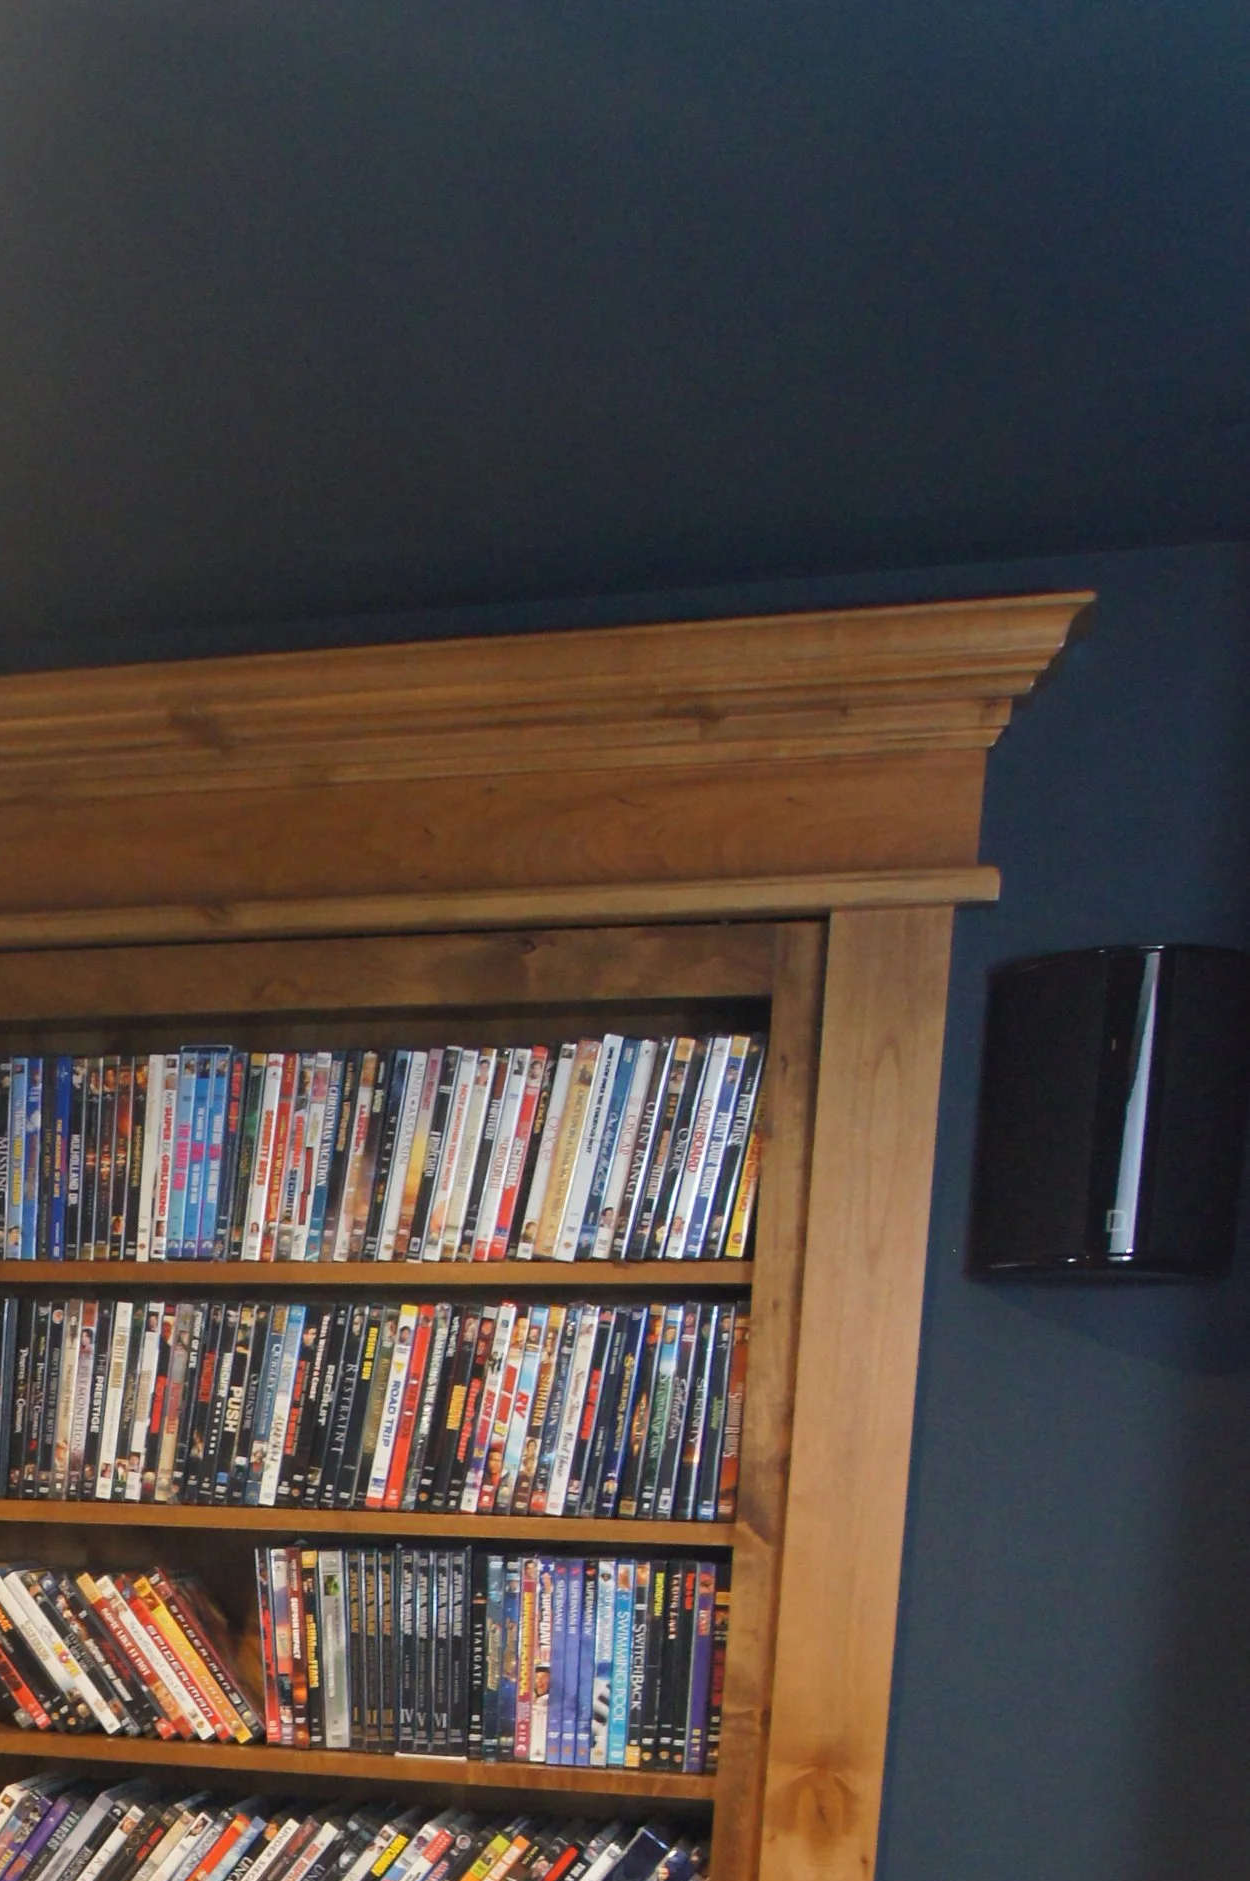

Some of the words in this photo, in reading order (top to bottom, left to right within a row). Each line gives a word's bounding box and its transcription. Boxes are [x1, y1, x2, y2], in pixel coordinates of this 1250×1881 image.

[163, 1107, 173, 1141] SUPER
[323, 1086, 339, 1140] CHRISTMAS
[638, 1101, 656, 1143] OPEN
[687, 1099, 712, 1173] OVERBOARD
[316, 1143, 332, 1187] VACATION
[625, 1149, 645, 1201] RANGE
[365, 1327, 379, 1359] RISING
[90, 1375, 105, 1433] PRESTIGE
[223, 1386, 242, 1433] PUSH
[331, 1363, 358, 1455] RESTRAINT
[387, 1380, 401, 1415] ROAD
[382, 1419, 394, 1447] TRIP
[473, 1623, 483, 1686] STARGATE
[614, 1611, 631, 1683] SWIMMING
[613, 1687, 626, 1722] POOL
